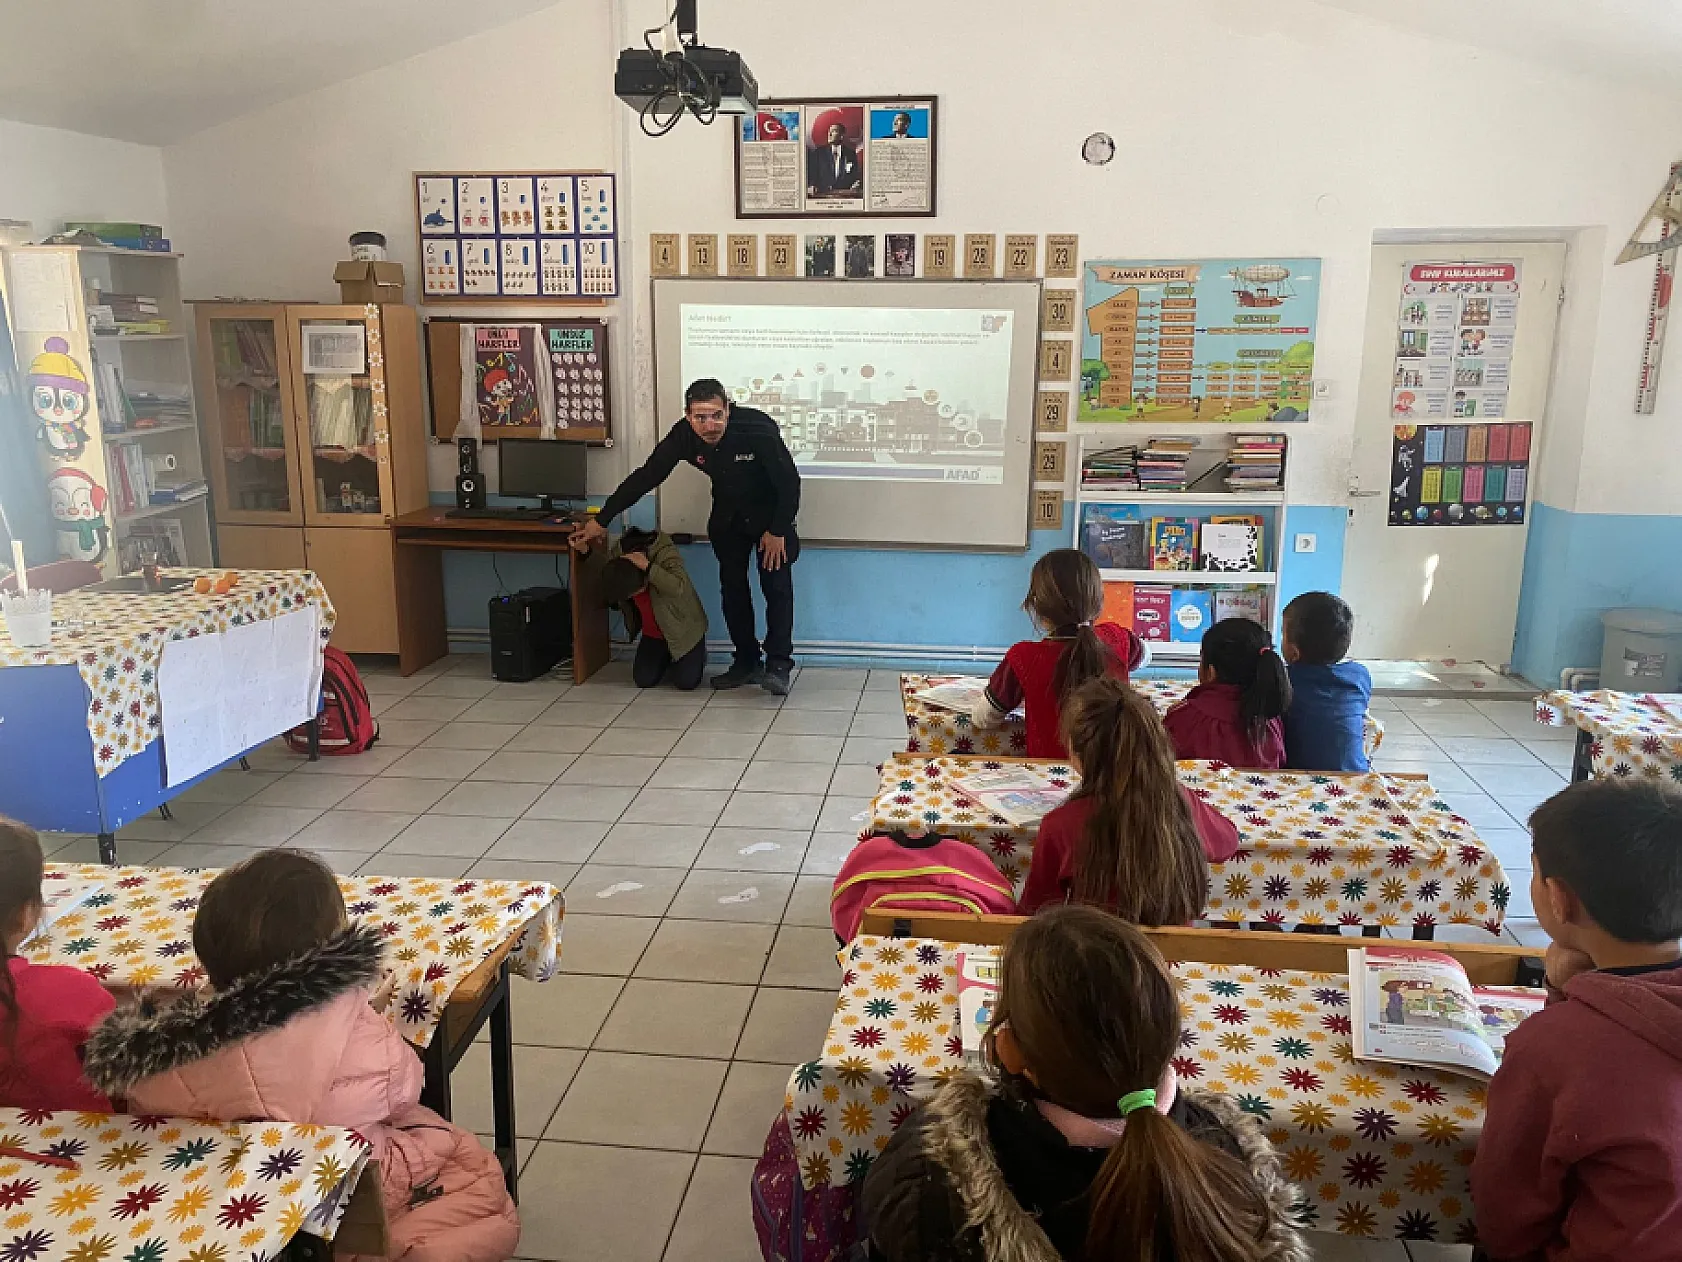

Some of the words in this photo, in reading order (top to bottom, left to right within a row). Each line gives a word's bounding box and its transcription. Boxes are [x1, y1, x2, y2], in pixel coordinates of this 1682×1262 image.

[422, 181, 428, 194] 1
[461, 181, 470, 194] 2
[501, 181, 509, 194] 3
[541, 180, 549, 193] 4
[581, 179, 590, 192] 5
[426, 242, 435, 254] 6
[466, 242, 474, 254] 7
[505, 242, 512, 256] 8
[544, 242, 551, 254] 9
[583, 242, 595, 254] 10
[661, 247, 669, 264] 4
[696, 247, 708, 264] 13
[737, 247, 748, 264] 18
[934, 249, 945, 266] 19
[1013, 249, 1028, 266] 22
[1109, 270, 1147, 279] ZAMAN
[1052, 302, 1066, 320] 30
[1052, 352, 1060, 369] 4
[945, 468, 979, 481] AFAD
[1042, 503, 1054, 518] 10
